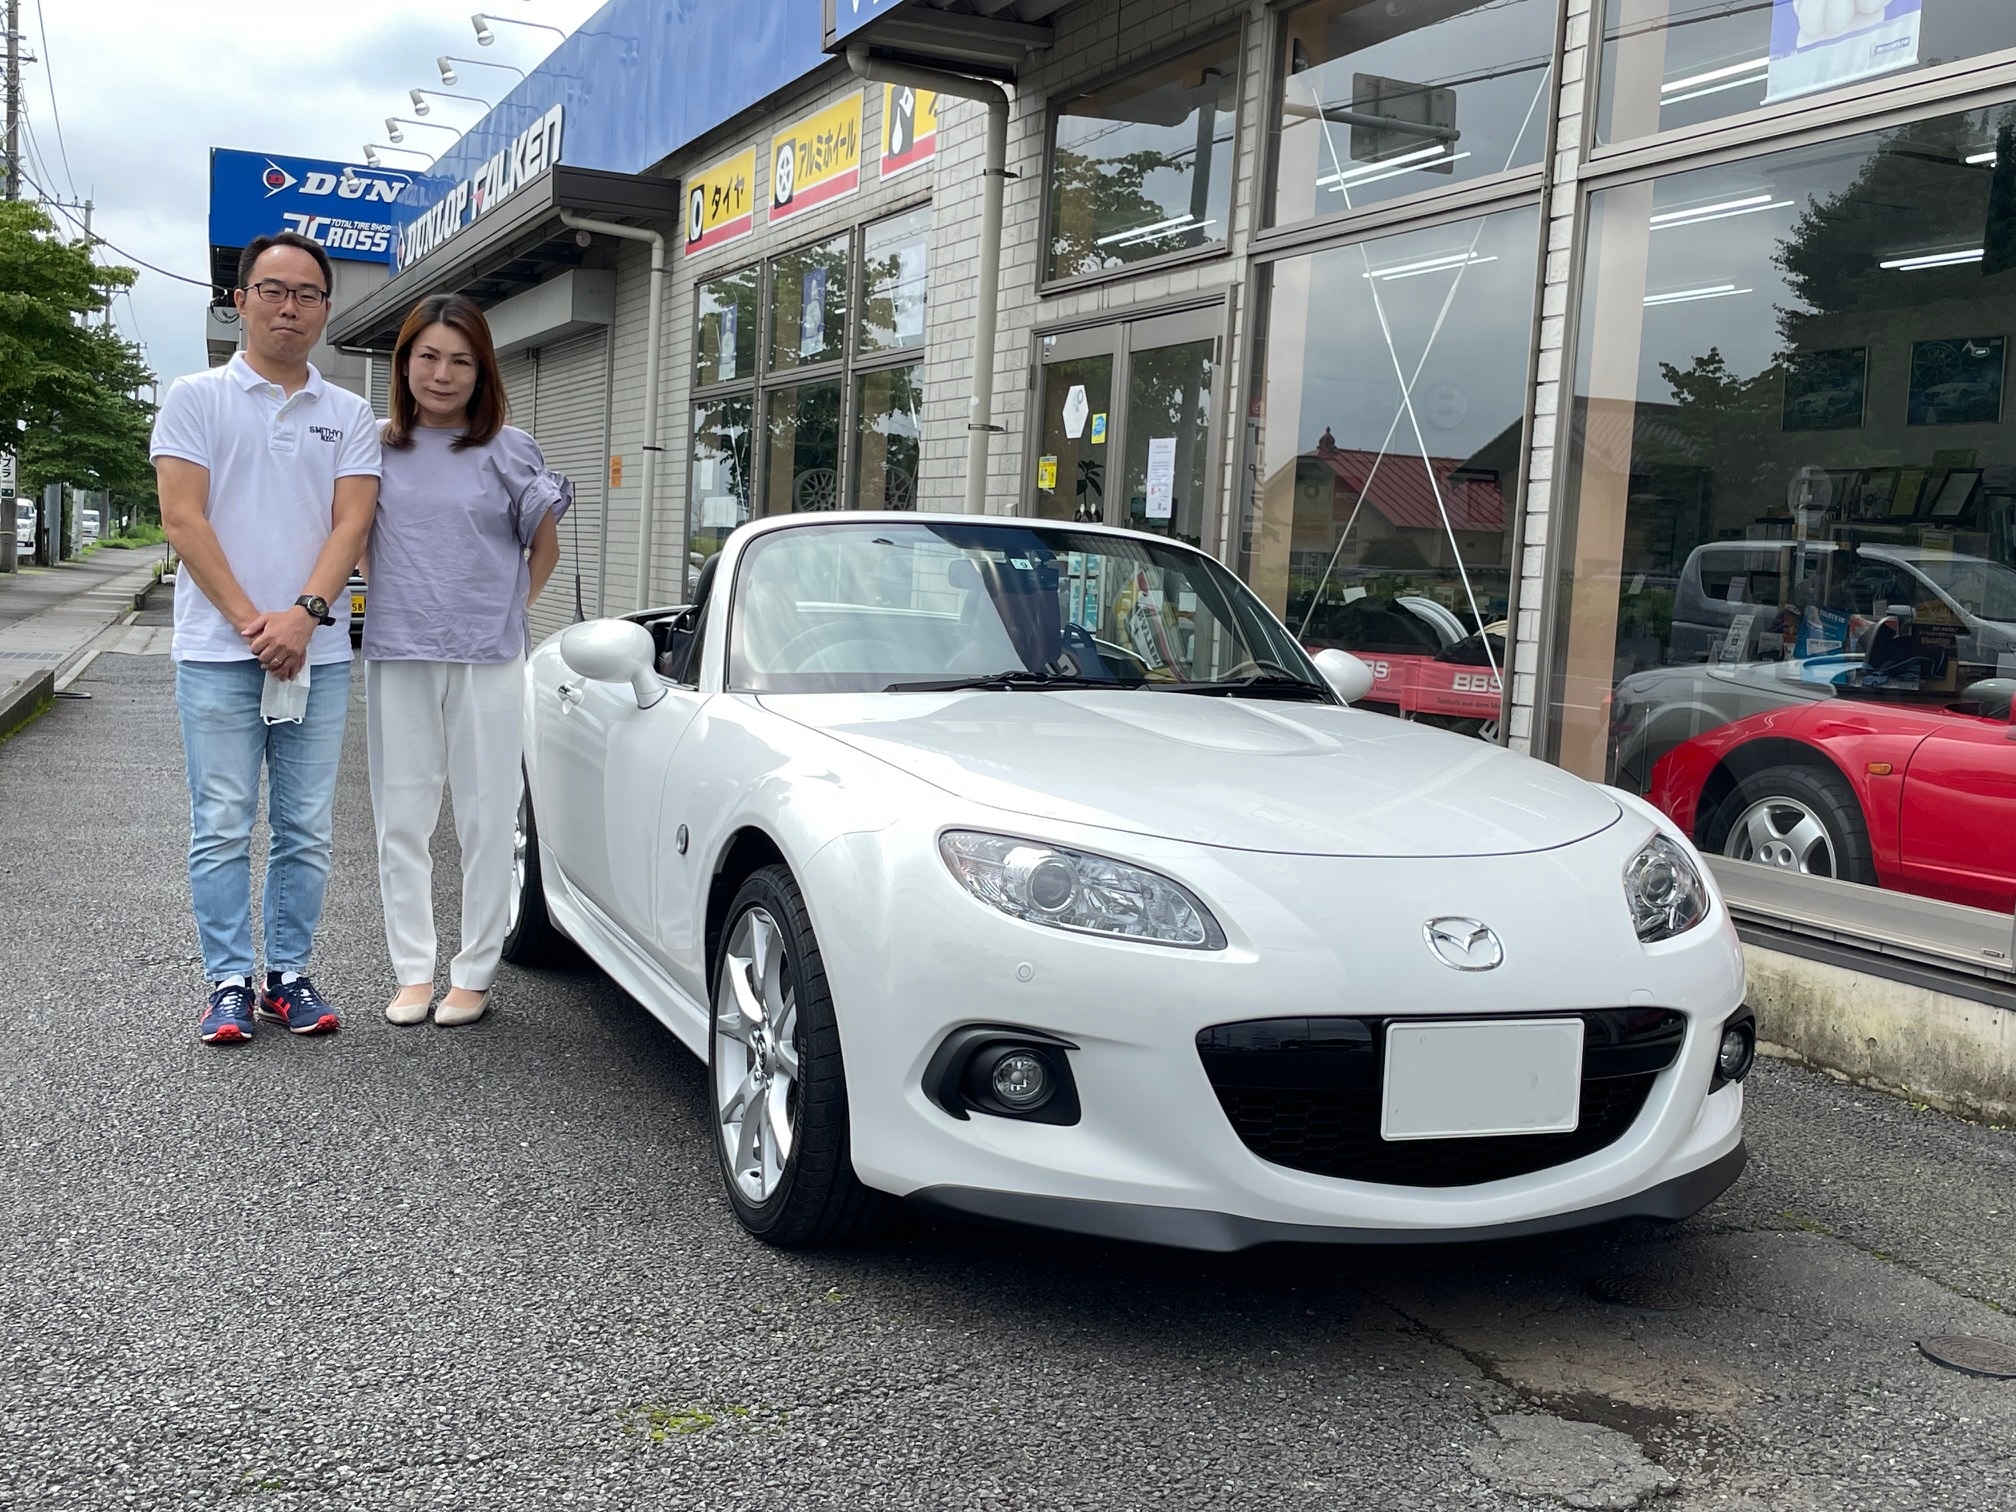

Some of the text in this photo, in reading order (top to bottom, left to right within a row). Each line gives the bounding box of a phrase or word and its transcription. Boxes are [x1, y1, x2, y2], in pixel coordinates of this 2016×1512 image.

[470, 104, 563, 221] FALKEN
[798, 118, 857, 182] アルミホイール
[299, 172, 405, 203] DUN
[711, 173, 745, 221] タイヤ
[331, 218, 391, 232] TOTAL TIRE SHOP
[404, 179, 469, 267] DUNLOP
[1452, 672, 1503, 693] BBS
